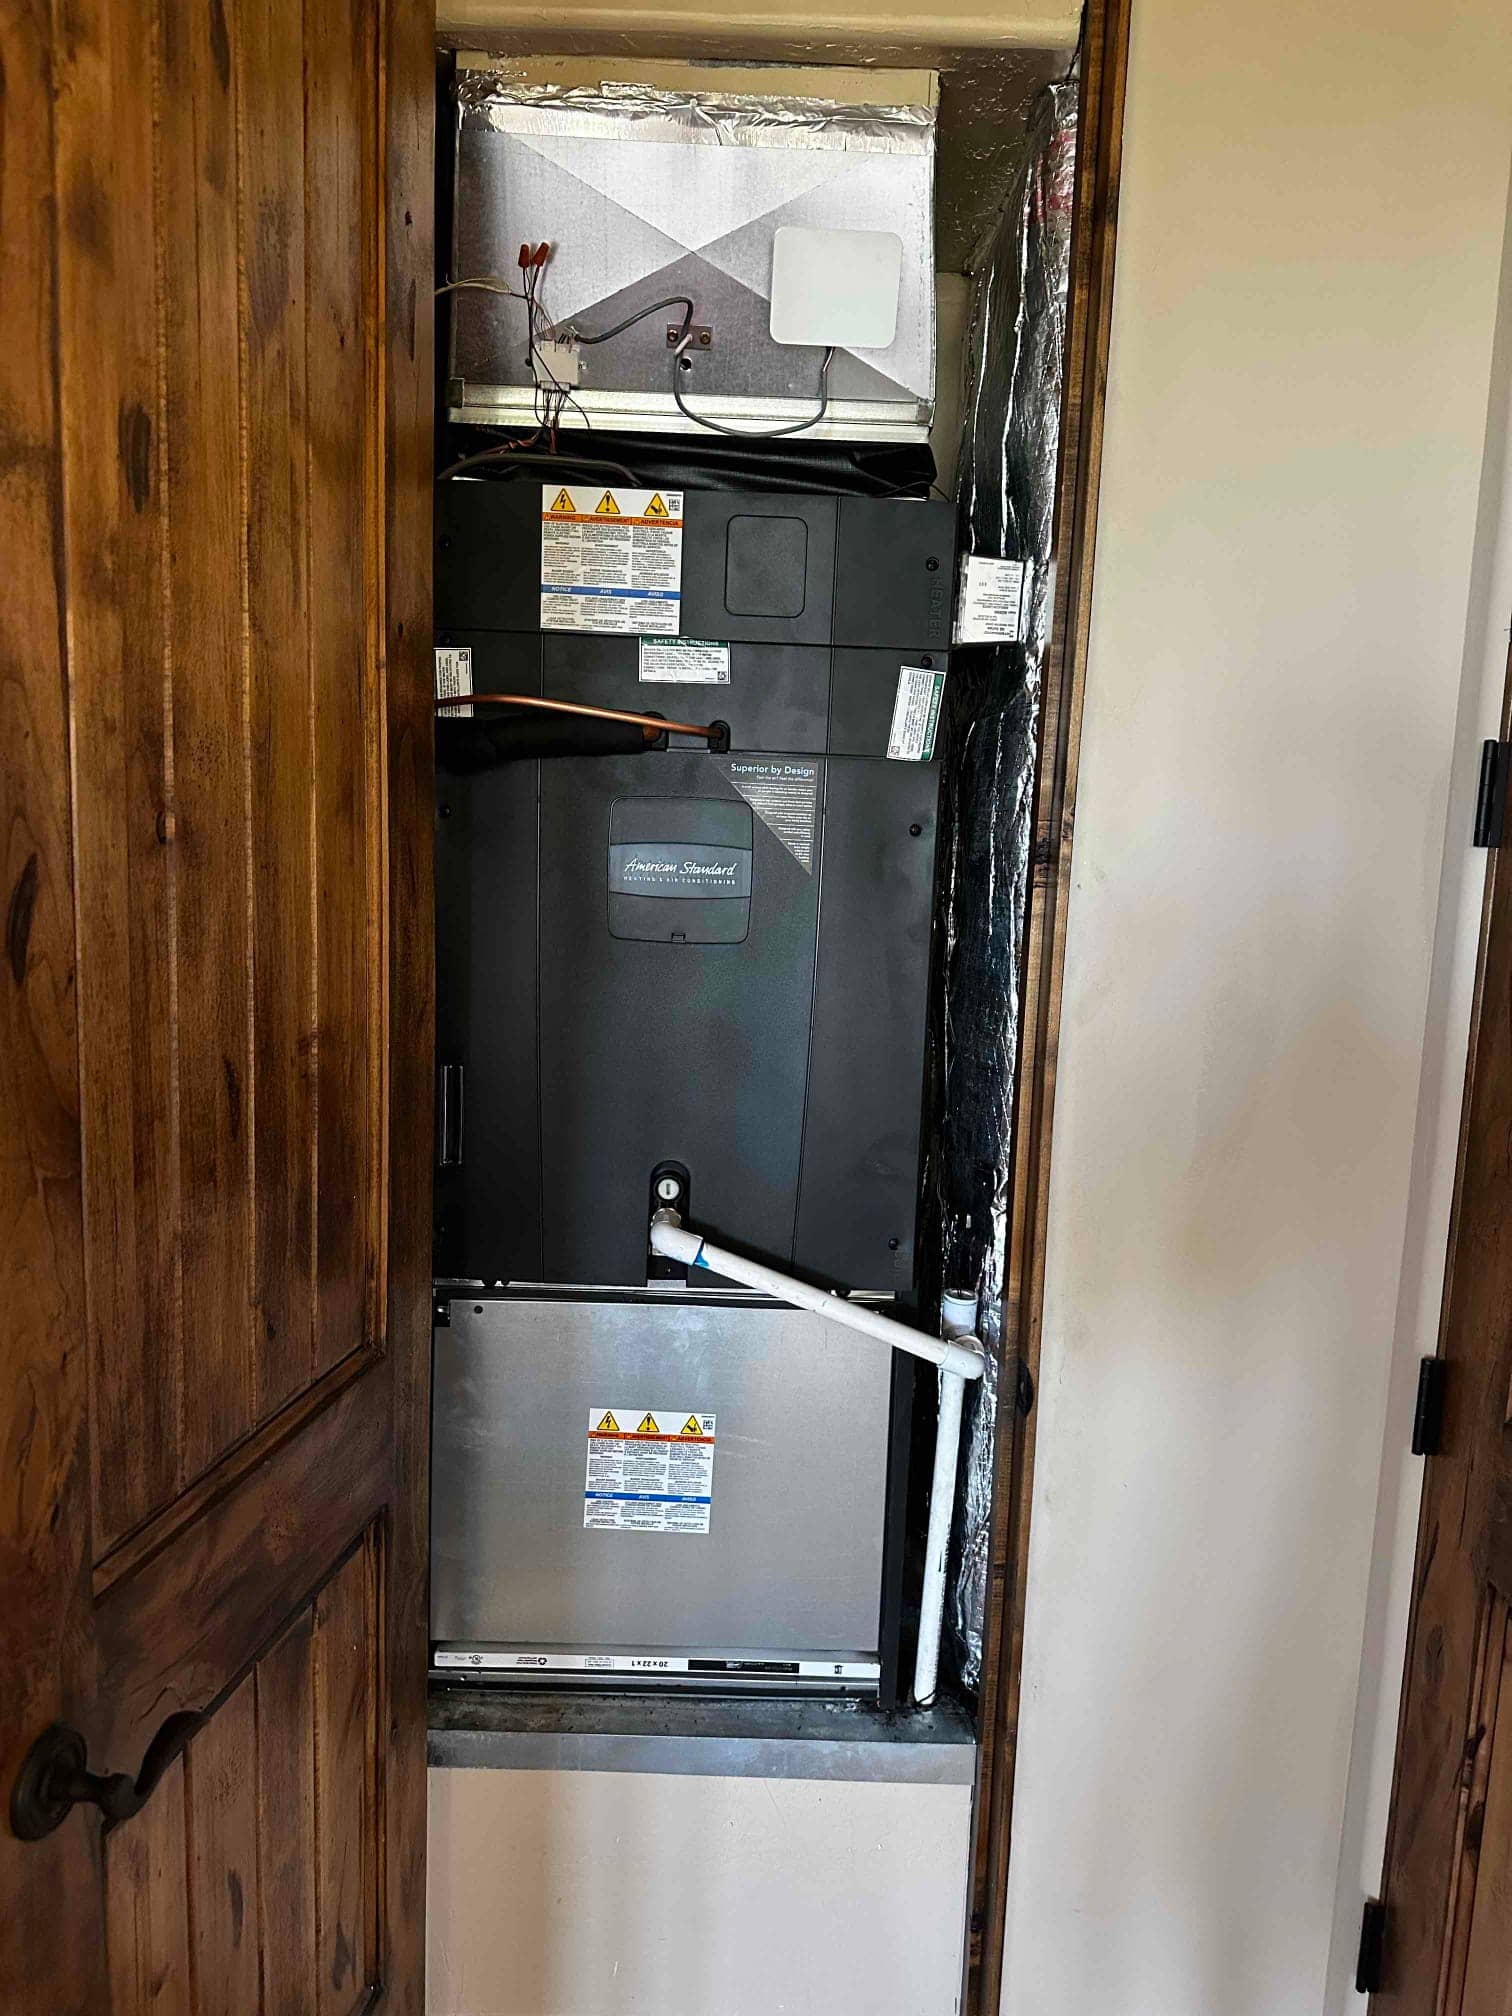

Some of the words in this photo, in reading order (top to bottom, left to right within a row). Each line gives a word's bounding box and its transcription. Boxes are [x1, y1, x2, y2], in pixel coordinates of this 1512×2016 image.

[731, 763, 769, 775] Superior
[771, 764, 782, 776] by
[784, 766, 815, 777] Design
[624, 857, 677, 873] American
[679, 861, 737, 876] Standard
[642, 1660, 652, 1668] 22
[658, 1660, 668, 1668] 20
